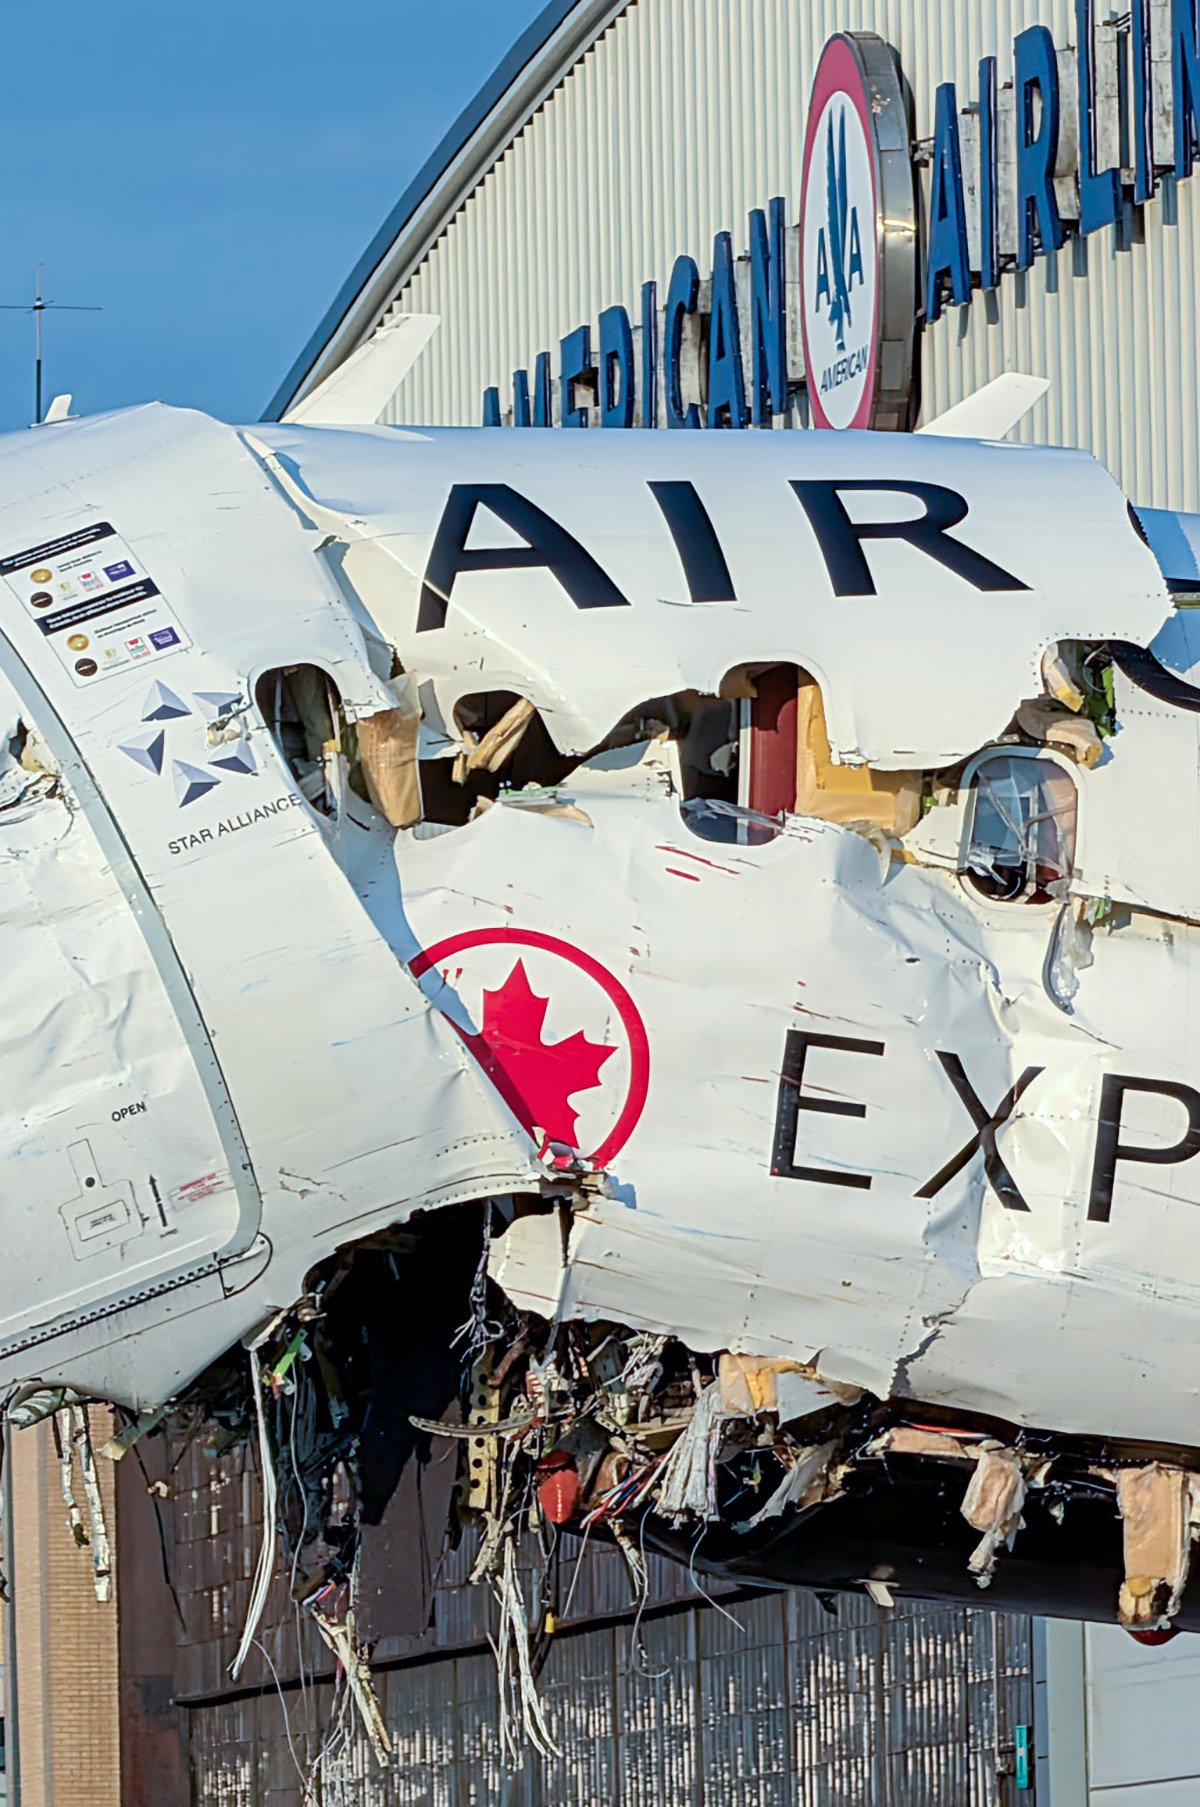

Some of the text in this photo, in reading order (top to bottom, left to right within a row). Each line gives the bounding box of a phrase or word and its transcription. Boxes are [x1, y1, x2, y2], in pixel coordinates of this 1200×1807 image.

[482, 196, 787, 429] ERICAN
[819, 344, 869, 396] AMERICAN
[415, 478, 1035, 633] AIR
[168, 793, 302, 855] STAR ALLIANCE
[111, 1101, 148, 1122] OPEN
[768, 1027, 1200, 1223] EXP
